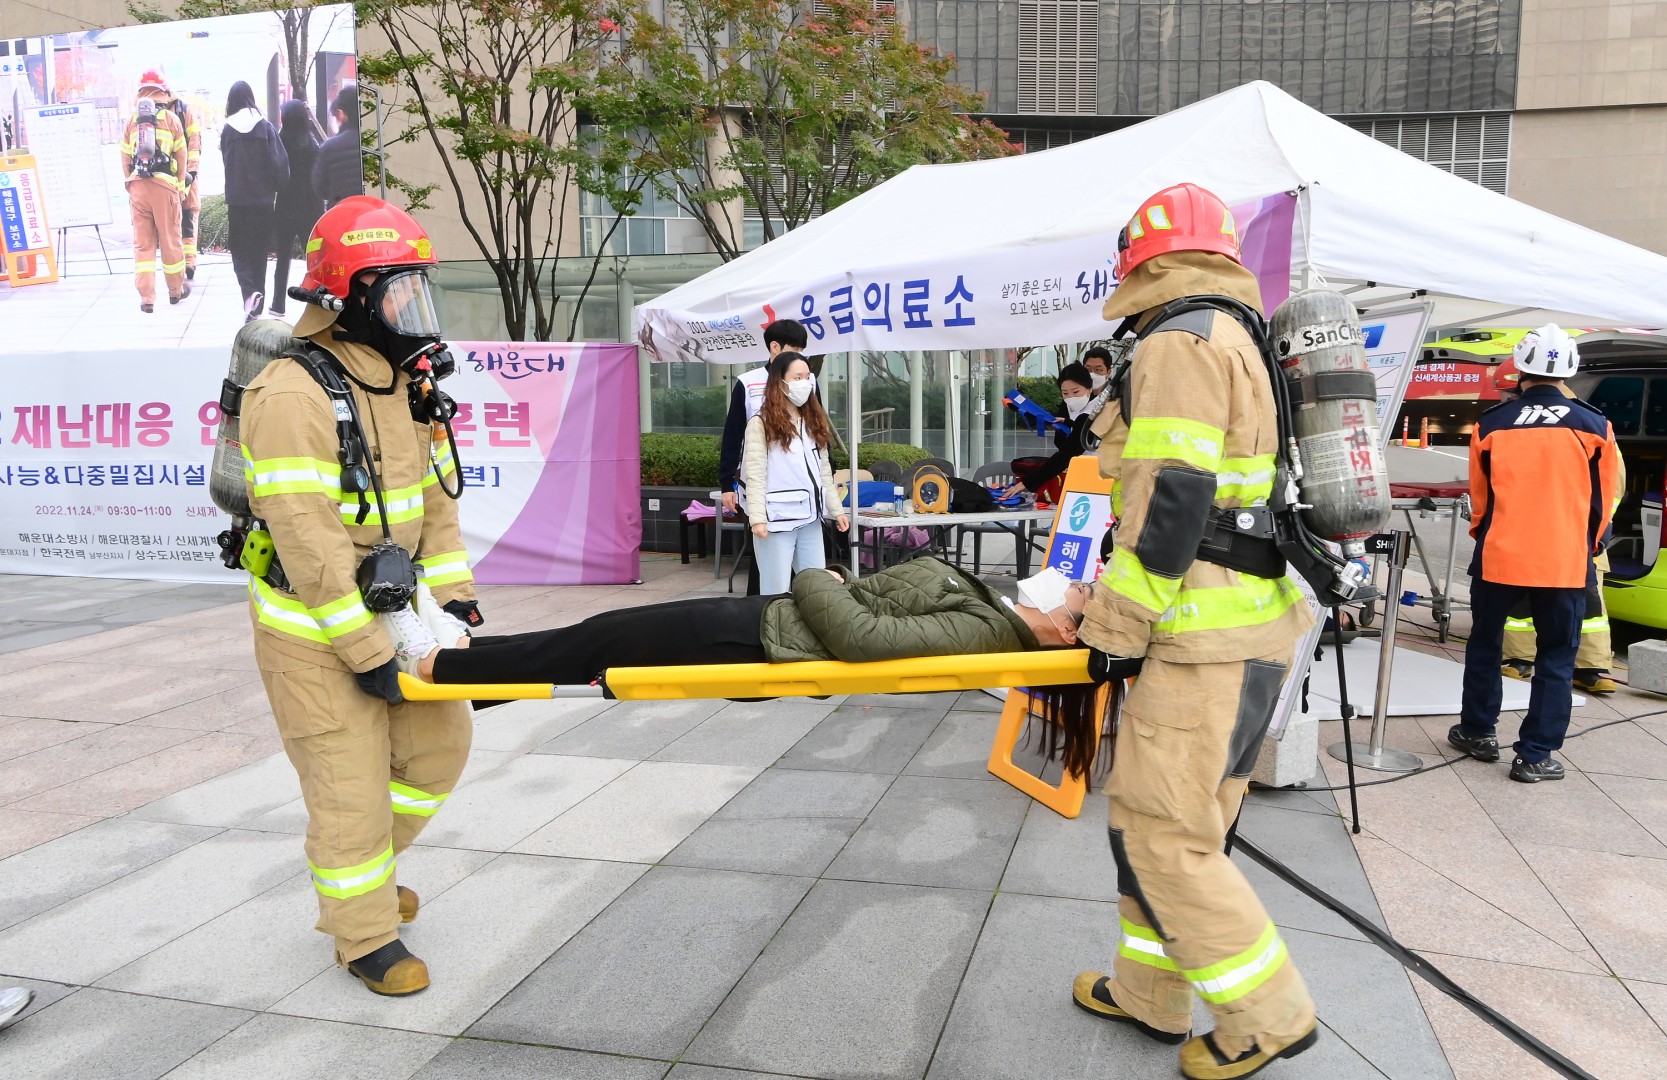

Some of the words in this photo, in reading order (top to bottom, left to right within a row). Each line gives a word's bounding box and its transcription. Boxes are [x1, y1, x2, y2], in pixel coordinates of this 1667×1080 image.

[1001, 282, 1020, 299] 살기
[1021, 279, 1040, 297] 좋은
[1042, 277, 1062, 293] 도시
[799, 275, 976, 341] 응급의료소
[1010, 302, 1028, 316] 오고
[1030, 299, 1050, 316] 싶은
[1052, 297, 1073, 312] 도시
[708, 314, 746, 333] 재난대응
[701, 331, 758, 352] 안전한국훈련
[465, 350, 565, 380] 해운대
[1429, 364, 1445, 372] 결제
[1446, 363, 1455, 372] 시
[1415, 373, 1461, 383] 신세계상품권
[1463, 373, 1480, 383] 증정
[11, 401, 173, 448] 재난대응
[107, 505, 172, 516] 09:30~11:00
[185, 505, 218, 517] 신세계
[19, 533, 88, 545] 해운대소방서
[98, 534, 163, 546] 해운대경찰서
[40, 548, 86, 559] 한국전력
[135, 549, 216, 562] 상수도사업본부
